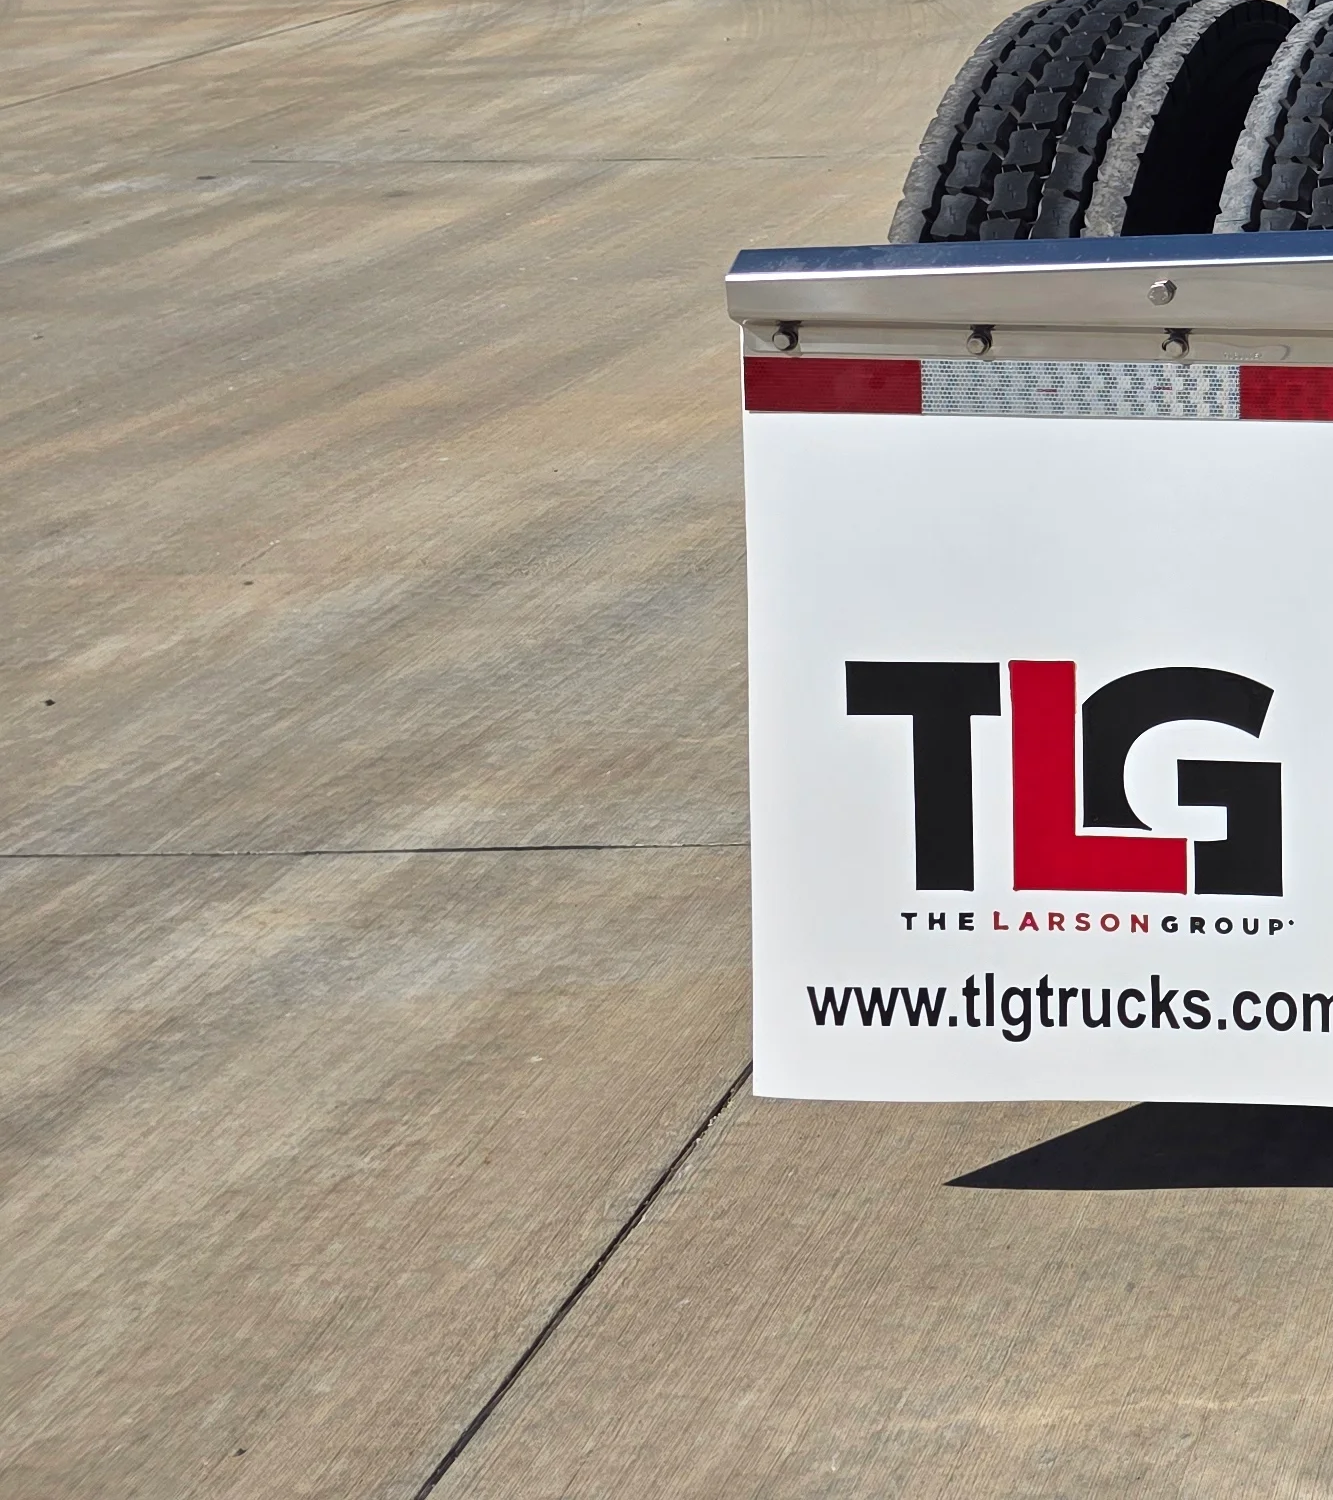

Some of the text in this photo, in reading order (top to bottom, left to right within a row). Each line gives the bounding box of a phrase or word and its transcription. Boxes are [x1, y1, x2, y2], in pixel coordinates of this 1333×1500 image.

[844, 660, 1284, 898] TLG
[900, 910, 1285, 937] THE LARSON GROUP
